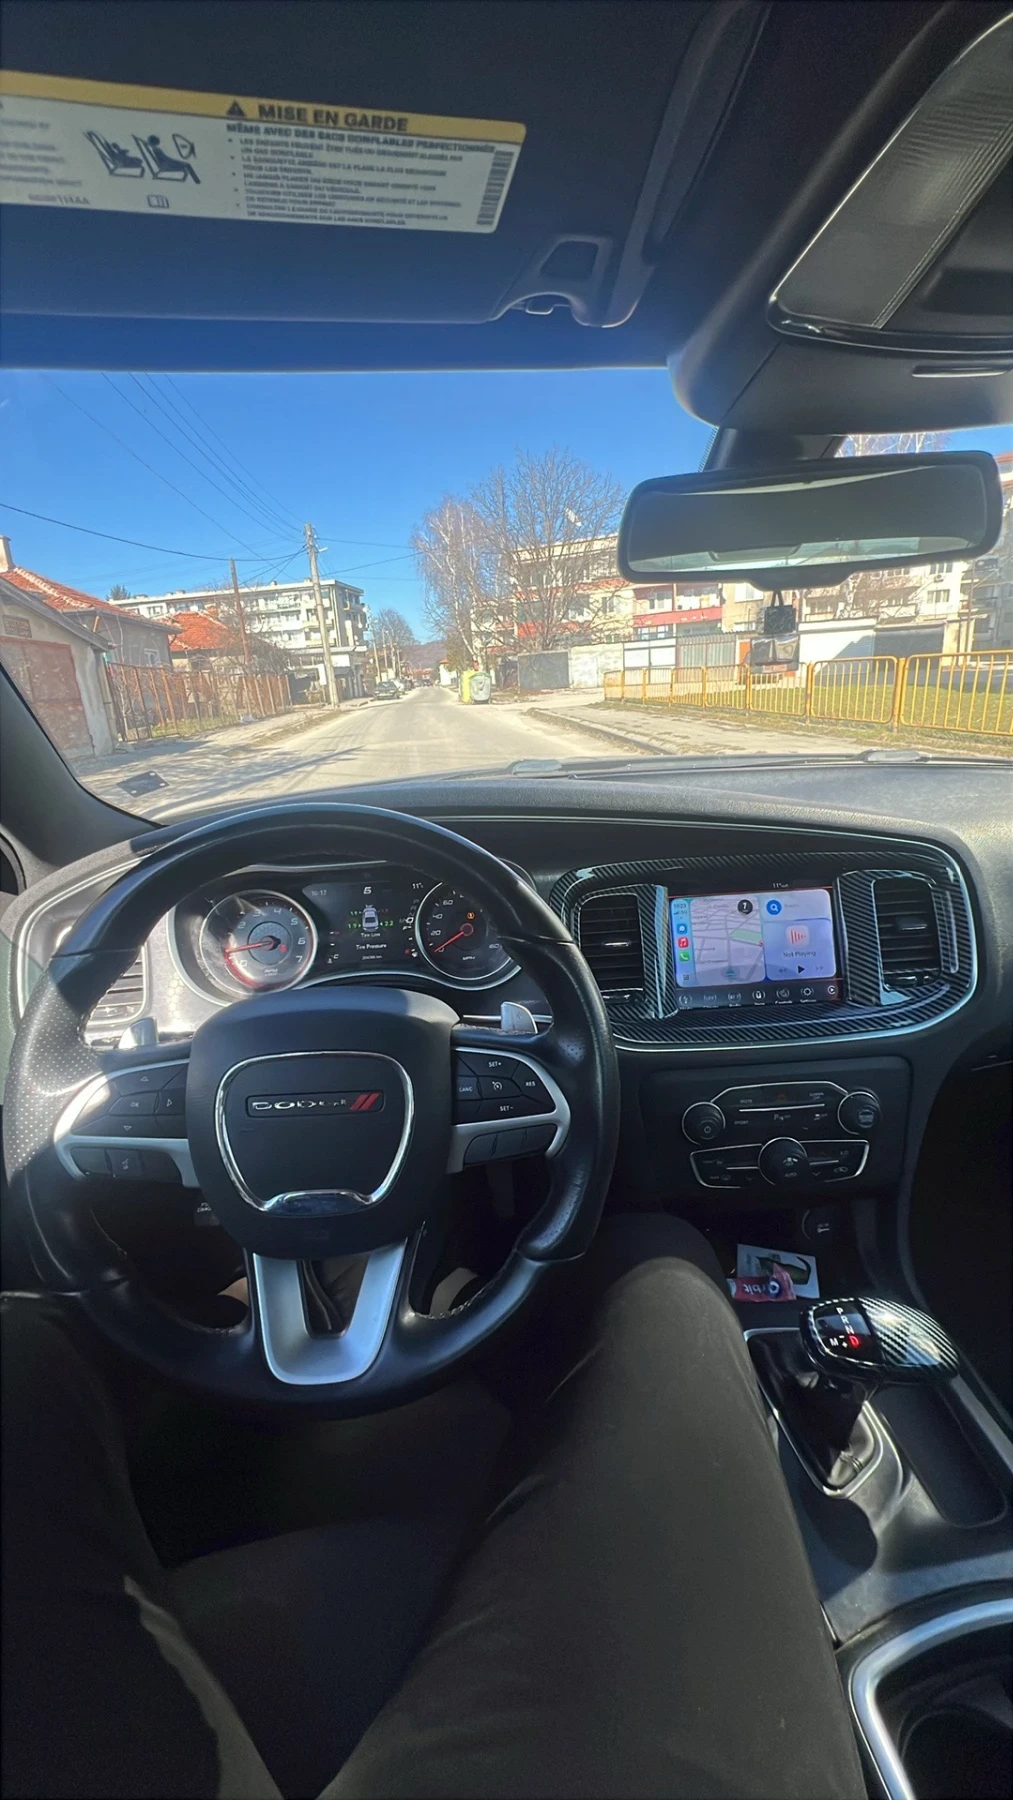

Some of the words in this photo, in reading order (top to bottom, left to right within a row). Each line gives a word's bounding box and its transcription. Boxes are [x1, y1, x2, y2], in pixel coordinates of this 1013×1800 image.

[258, 104, 307, 122] MISE
[313, 109, 339, 125] EN
[344, 112, 409, 131] GARDE
[263, 127, 292, 137] AVEC
[298, 937, 306, 945] 6
[296, 955, 303, 963] 7
[836, 1307, 844, 1316] P
[841, 1314, 850, 1324] R
[844, 1325, 855, 1335] N
[830, 1337, 839, 1347] M
[849, 1335, 860, 1348] D
